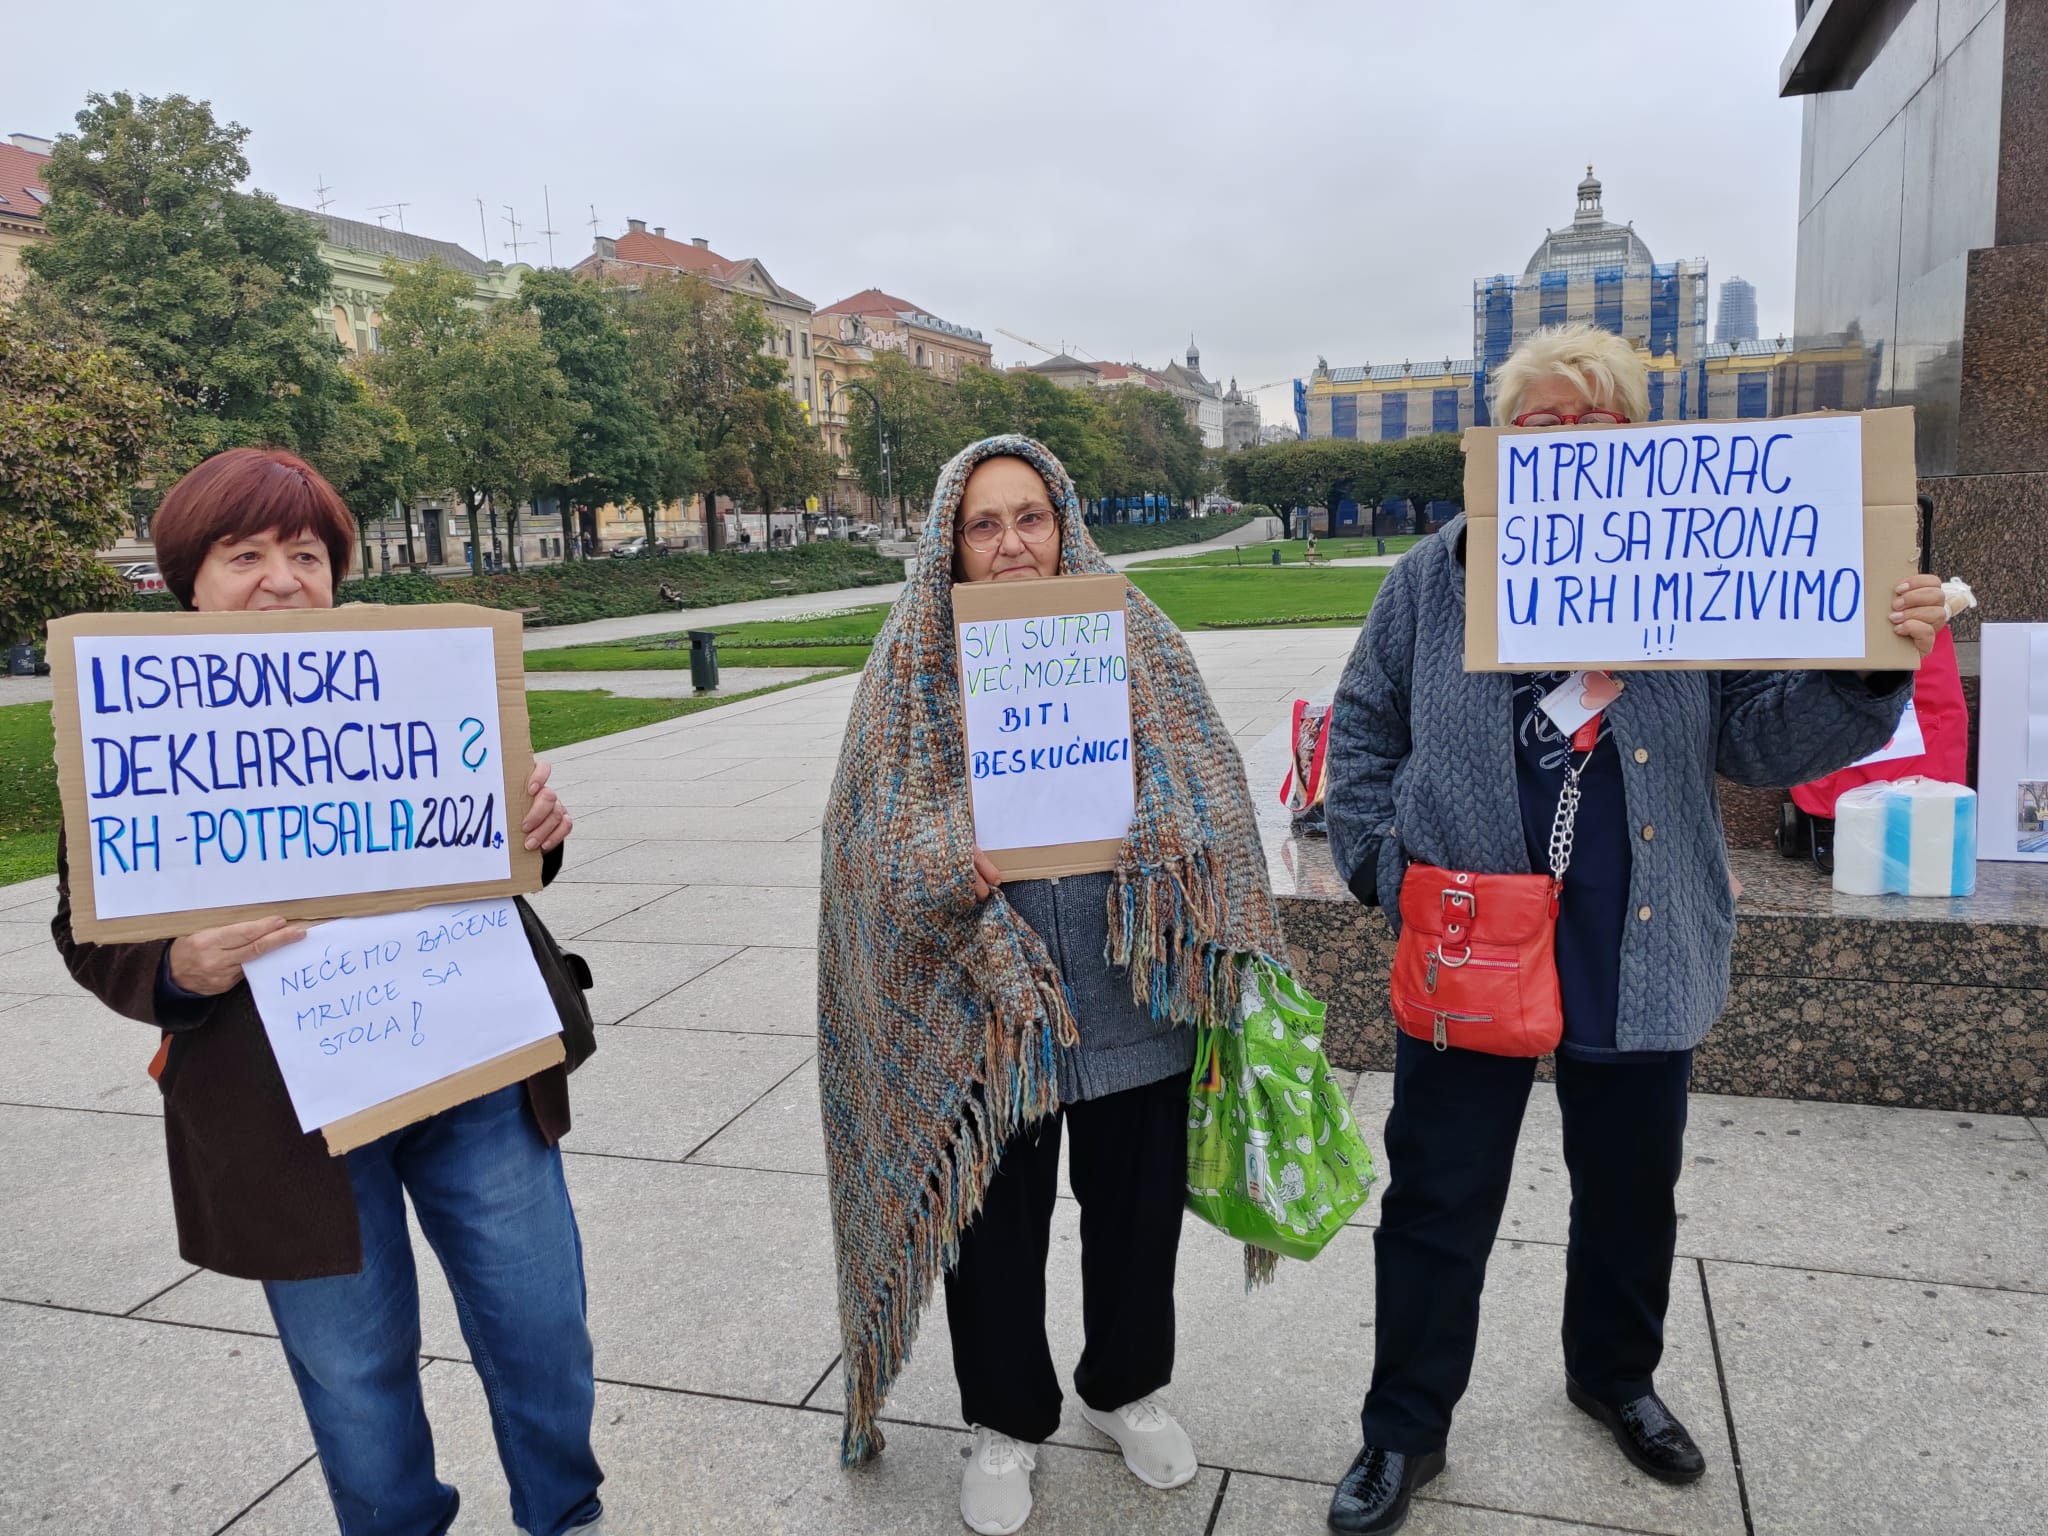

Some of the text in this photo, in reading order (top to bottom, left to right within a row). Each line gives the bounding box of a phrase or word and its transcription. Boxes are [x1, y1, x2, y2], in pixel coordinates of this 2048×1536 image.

[1502, 513, 1583, 566] SIĐI
[1661, 504, 1819, 560] TRONA
[1506, 576, 1539, 626] U
[1555, 574, 1615, 626] RH
[965, 613, 1112, 658] SVI SUTRA
[91, 650, 381, 714] LISABONSKA
[1023, 650, 1127, 692] MOŽEMO
[999, 702, 1070, 733] BITI
[91, 721, 438, 800] DEKLARACIJA
[281, 941, 402, 996] NEĆEMO
[296, 961, 463, 1032] MRVICE SA
[319, 1001, 425, 1056] STOLA!
